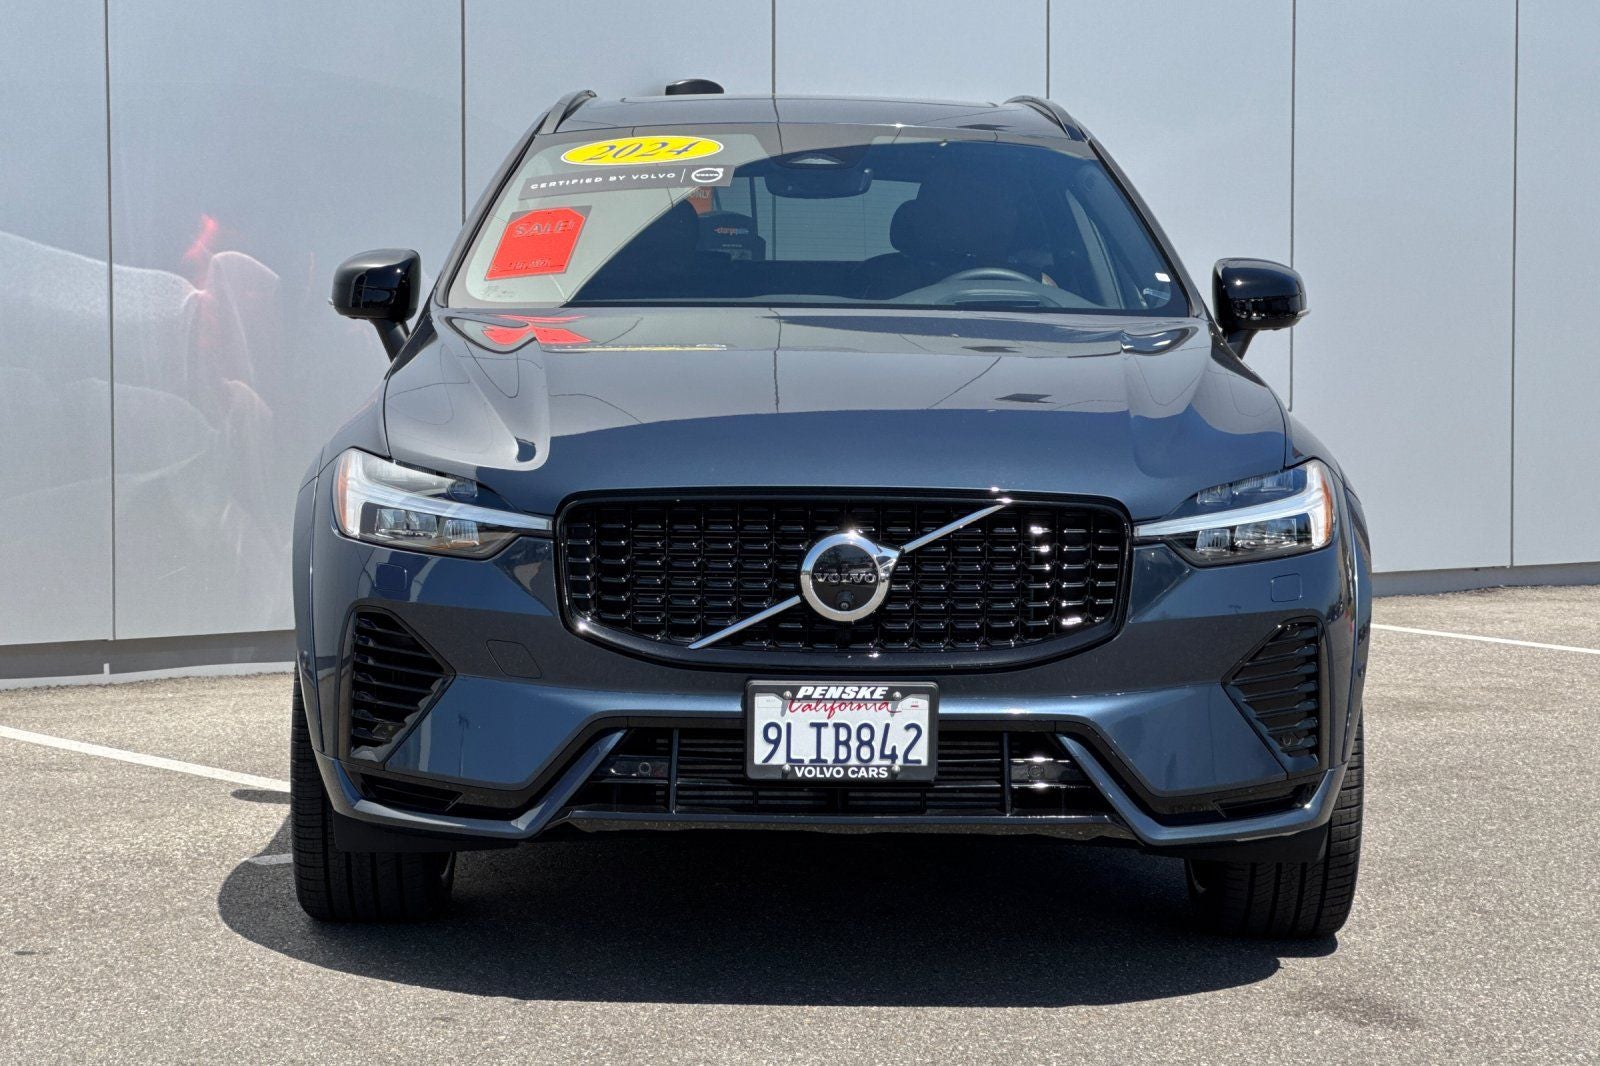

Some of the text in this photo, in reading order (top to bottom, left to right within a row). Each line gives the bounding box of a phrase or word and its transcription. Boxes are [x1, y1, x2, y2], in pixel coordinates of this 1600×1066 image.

[583, 140, 701, 162] 2024
[530, 172, 676, 190] CERTIFIED BY VOLVO
[813, 572, 876, 583] VOLVO
[795, 686, 888, 700] PENSKE
[788, 698, 902, 719] California
[762, 721, 923, 765] 9LIB842
[794, 766, 888, 778] VOLVO CARS
